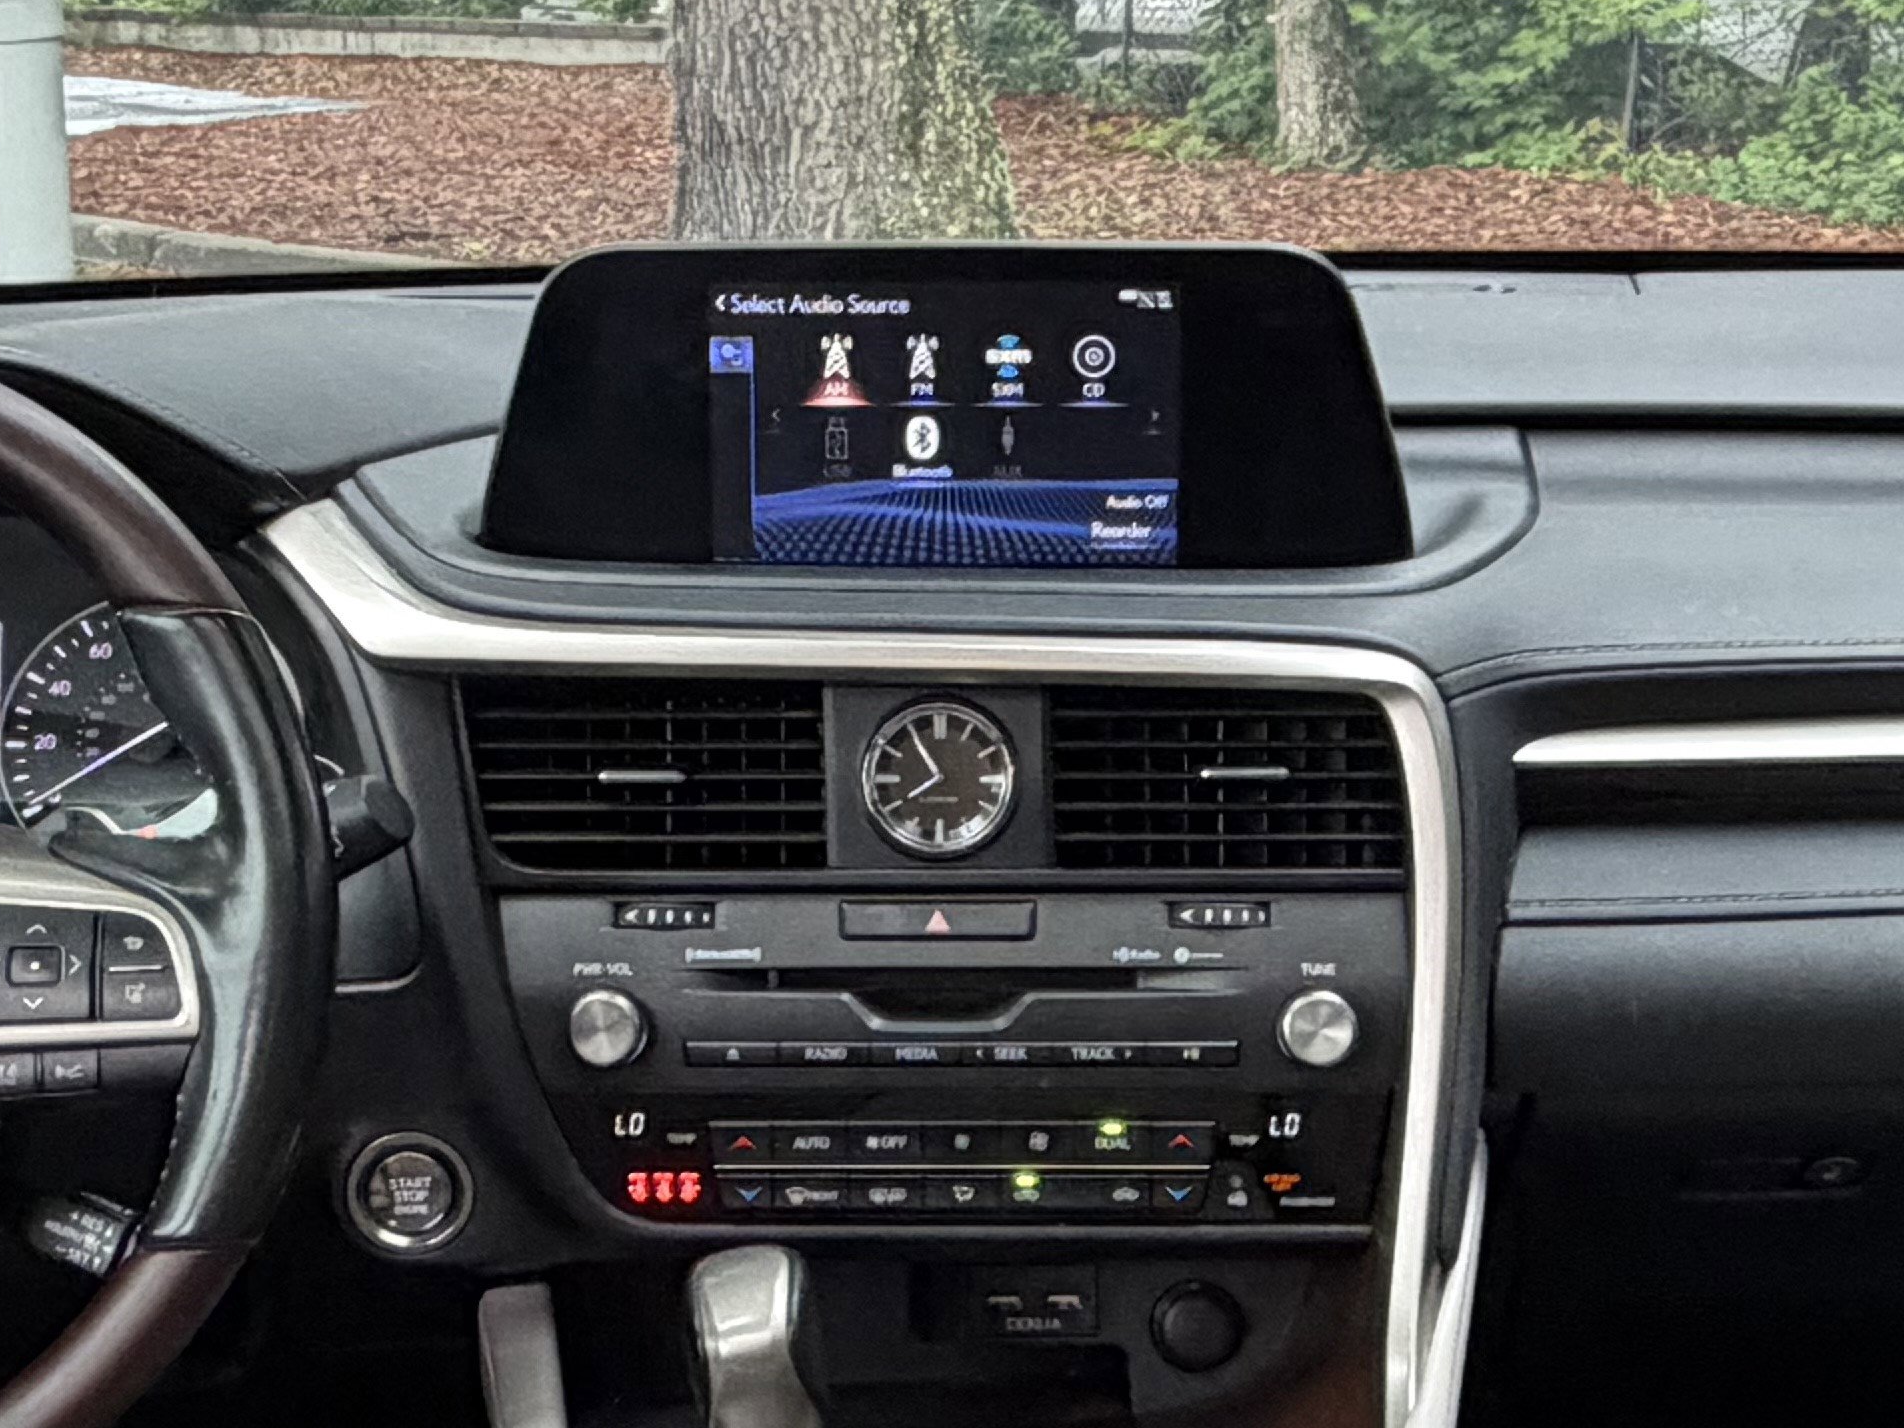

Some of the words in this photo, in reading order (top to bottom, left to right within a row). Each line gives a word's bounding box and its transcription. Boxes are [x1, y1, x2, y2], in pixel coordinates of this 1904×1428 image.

[730, 294, 785, 314] Select
[789, 293, 844, 314] Audio
[847, 296, 911, 315] Source
[824, 382, 849, 398] AM
[910, 382, 935, 398] FM
[1081, 382, 1106, 398] CD
[1105, 494, 1143, 510] Audio
[1144, 494, 1169, 510] Off
[1090, 522, 1152, 539] Reorder
[89, 642, 114, 660] 60
[48, 679, 72, 696] 40
[33, 732, 58, 751] 20
[1299, 962, 1337, 978] TUNE
[804, 1047, 848, 1061] RADIO
[895, 1047, 938, 1061] MEDIA
[993, 1047, 1028, 1061] SEEK
[1071, 1047, 1115, 1061] TRACK
[613, 1111, 646, 1137] LO
[1267, 1111, 1302, 1139] LO
[792, 1136, 832, 1150] AUTO
[388, 1175, 432, 1190] START
[394, 1190, 430, 1203] STOP
